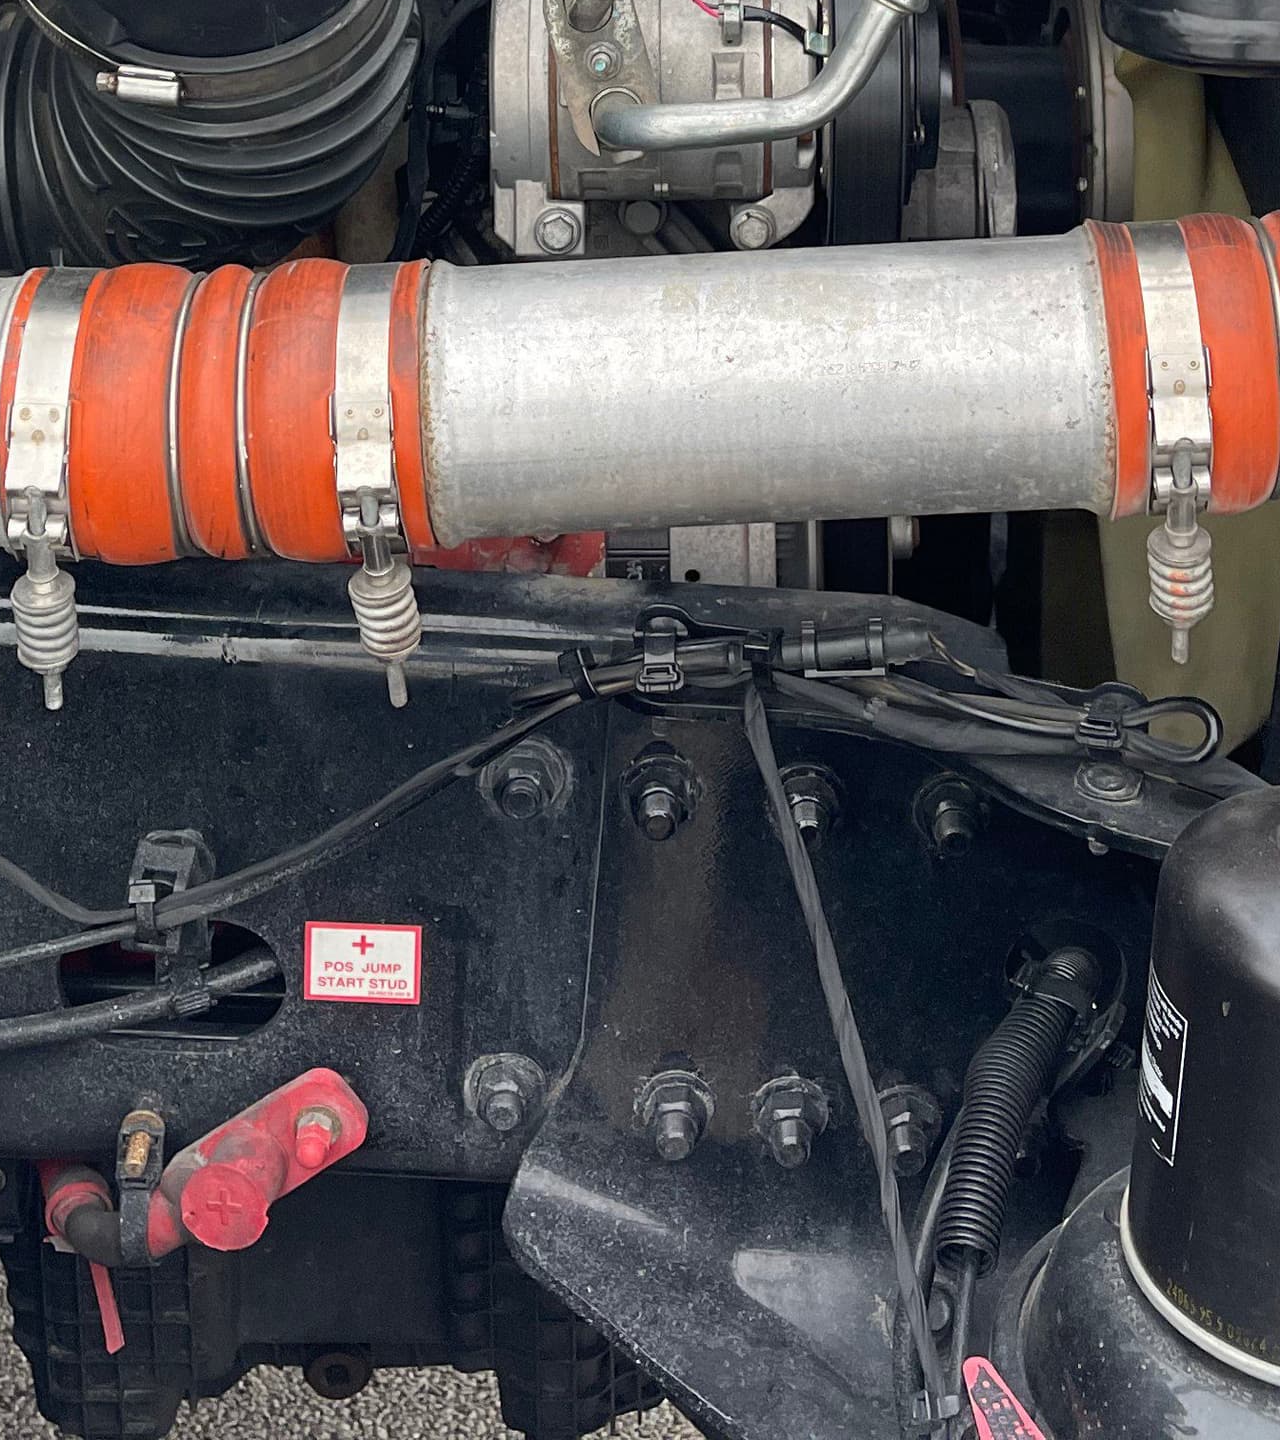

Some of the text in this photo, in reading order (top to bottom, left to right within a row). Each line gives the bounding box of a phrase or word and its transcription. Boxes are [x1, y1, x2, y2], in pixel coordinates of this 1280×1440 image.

[324, 961, 402, 974] POS JUMP
[317, 976, 408, 990] START STUD
